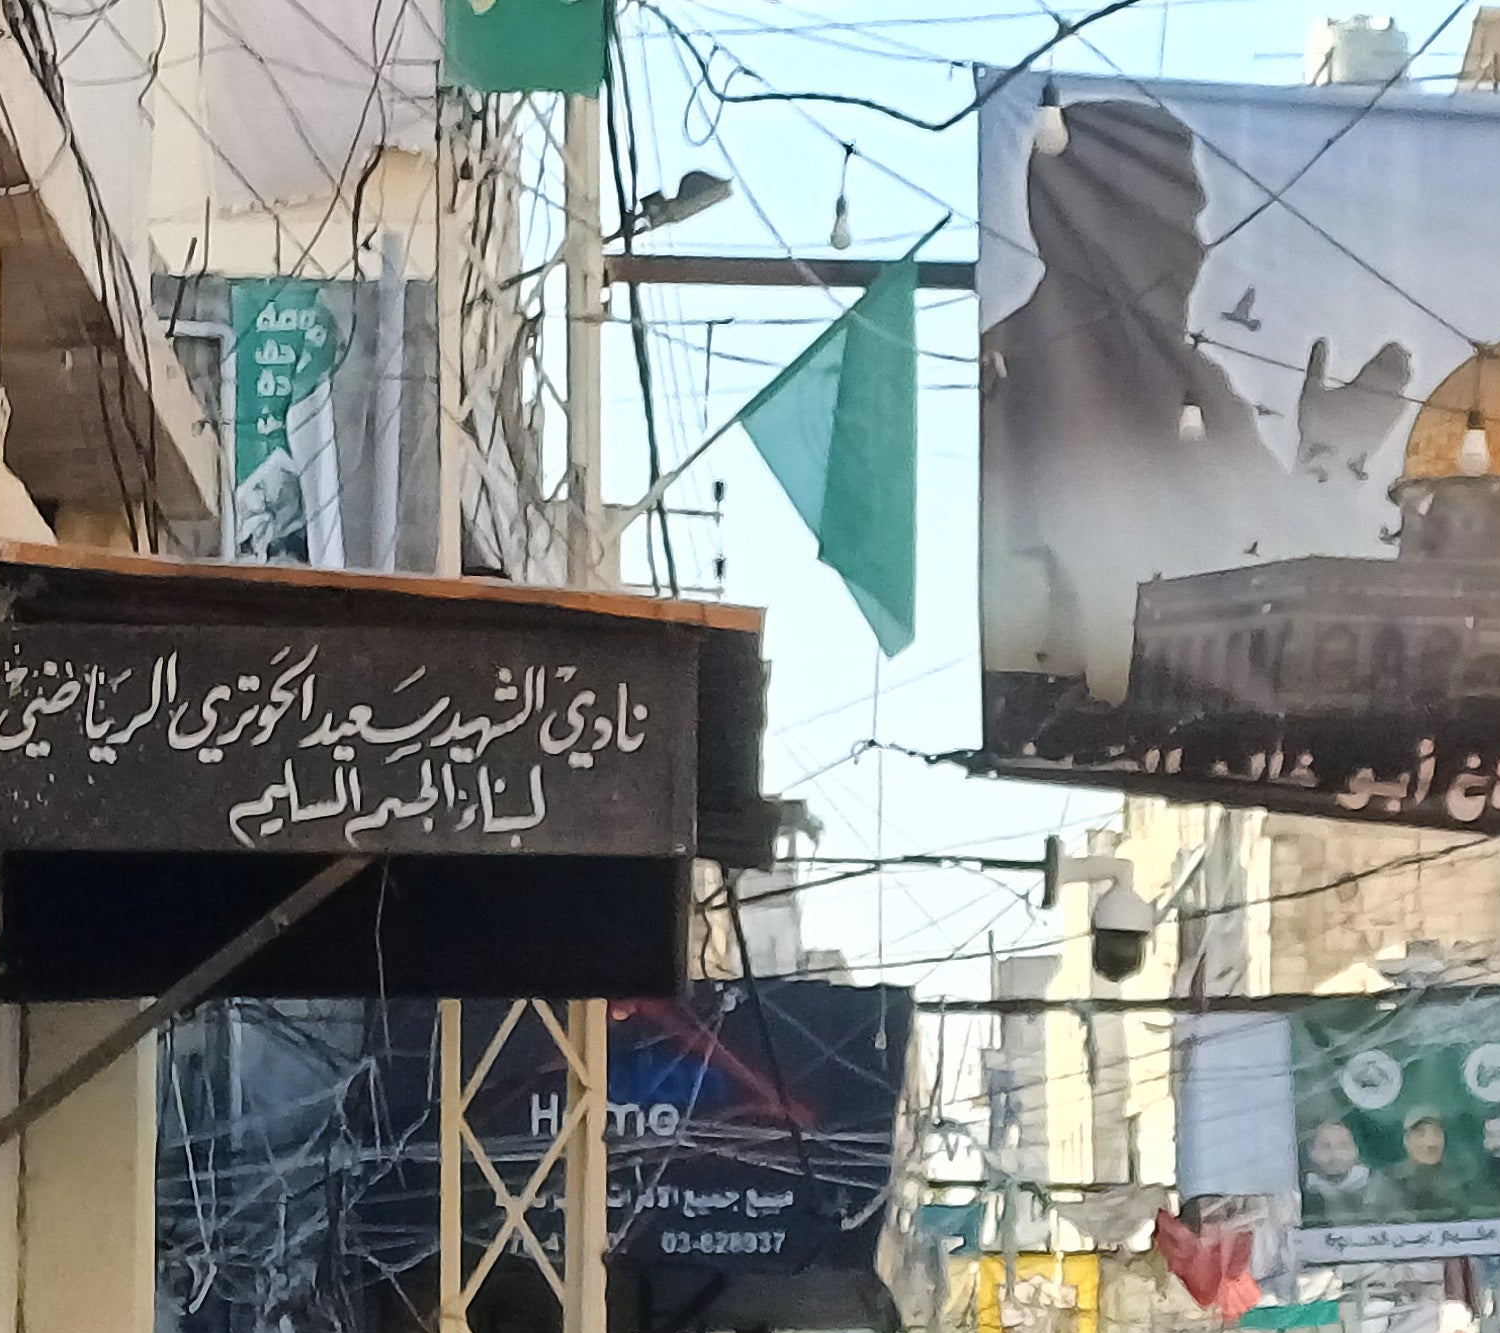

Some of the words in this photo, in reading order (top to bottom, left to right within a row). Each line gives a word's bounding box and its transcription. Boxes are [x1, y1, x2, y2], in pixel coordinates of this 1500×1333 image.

[304, 664, 451, 764] سعيد
[428, 664, 544, 762] الشهيد
[540, 662, 648, 770] نادي
